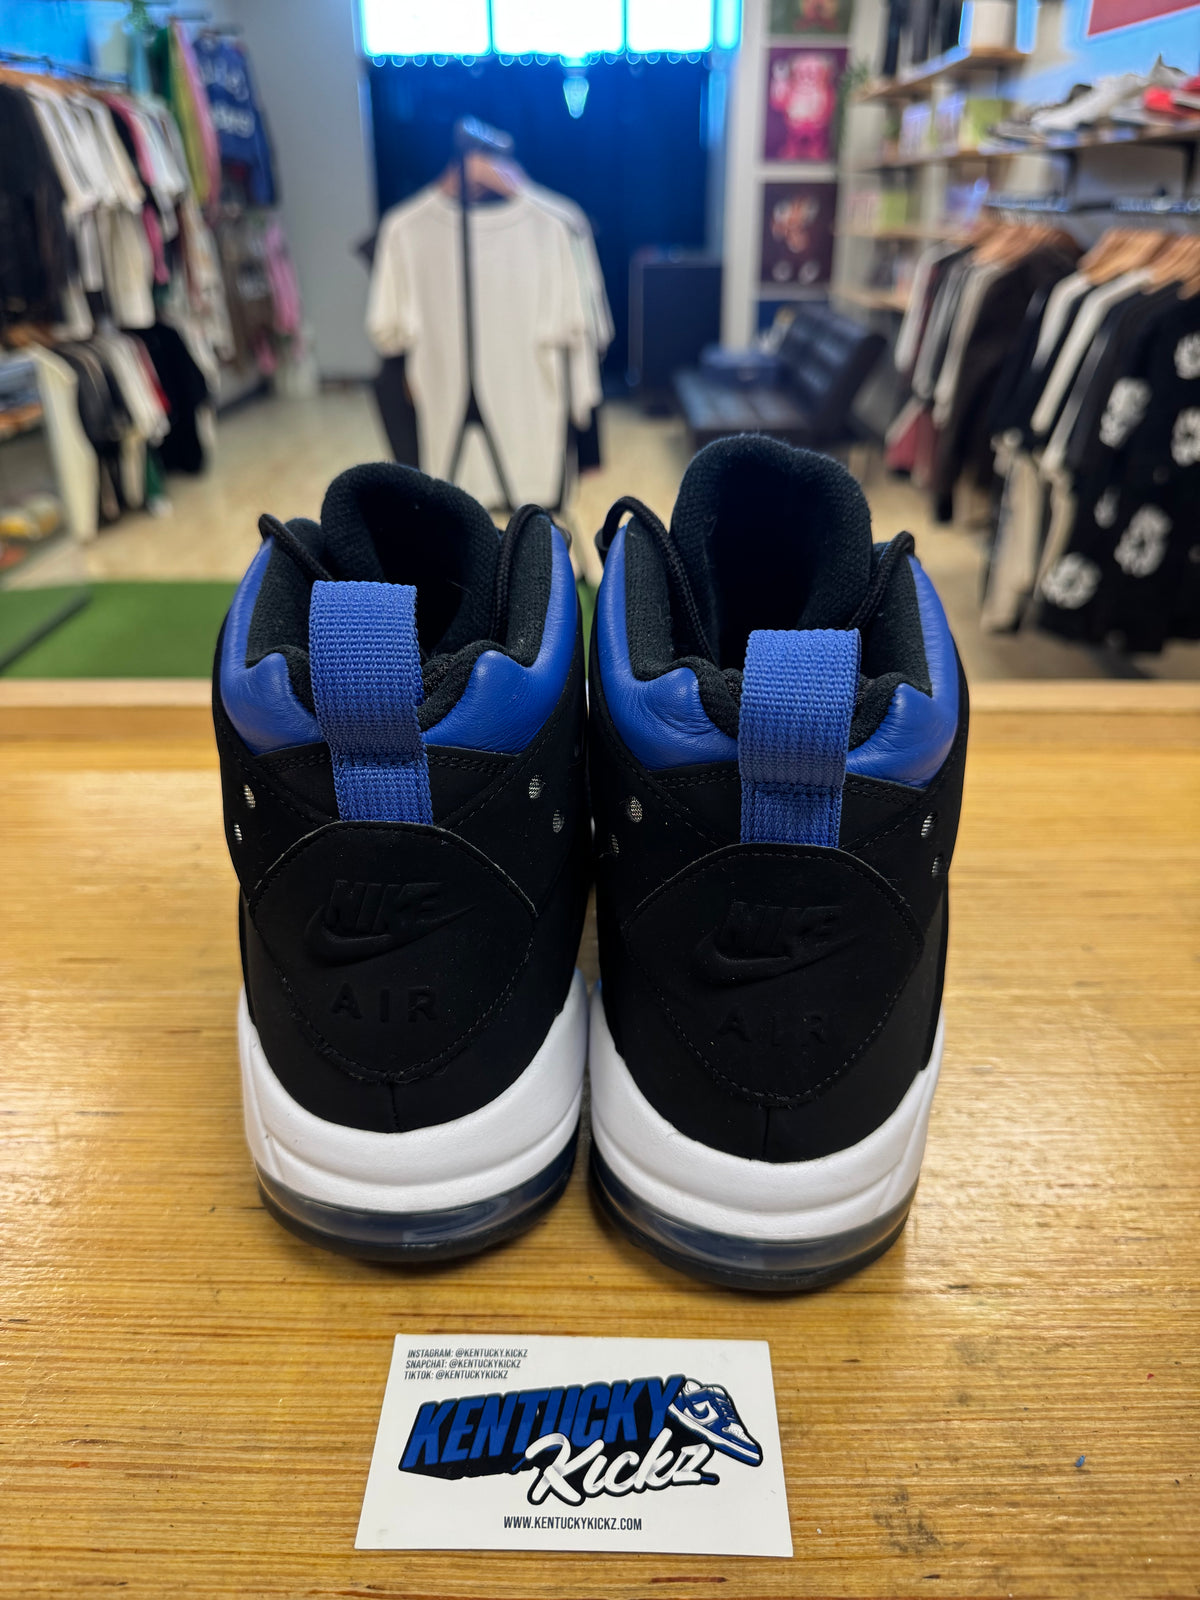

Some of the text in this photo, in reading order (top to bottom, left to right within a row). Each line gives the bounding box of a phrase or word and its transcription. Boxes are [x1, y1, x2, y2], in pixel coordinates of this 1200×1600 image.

[325, 879, 445, 934] NIKE
[714, 900, 843, 955] NIKE
[331, 982, 437, 1023] AIR
[717, 1008, 827, 1048] AIR
[405, 1358, 521, 1369] SNAPCHAT: @KENTUCKYKICKZ
[407, 1348, 528, 1358] INSTAGRAM: @KENTUCKY.KICKZ
[404, 1369, 509, 1380] TIKTOK: @KENTUCKYKICKZ
[401, 1374, 686, 1469] KENTUCKY
[524, 1427, 715, 1504] Kickz
[503, 1515, 642, 1531] WWW.KENTUCKYKICKZ.COM
